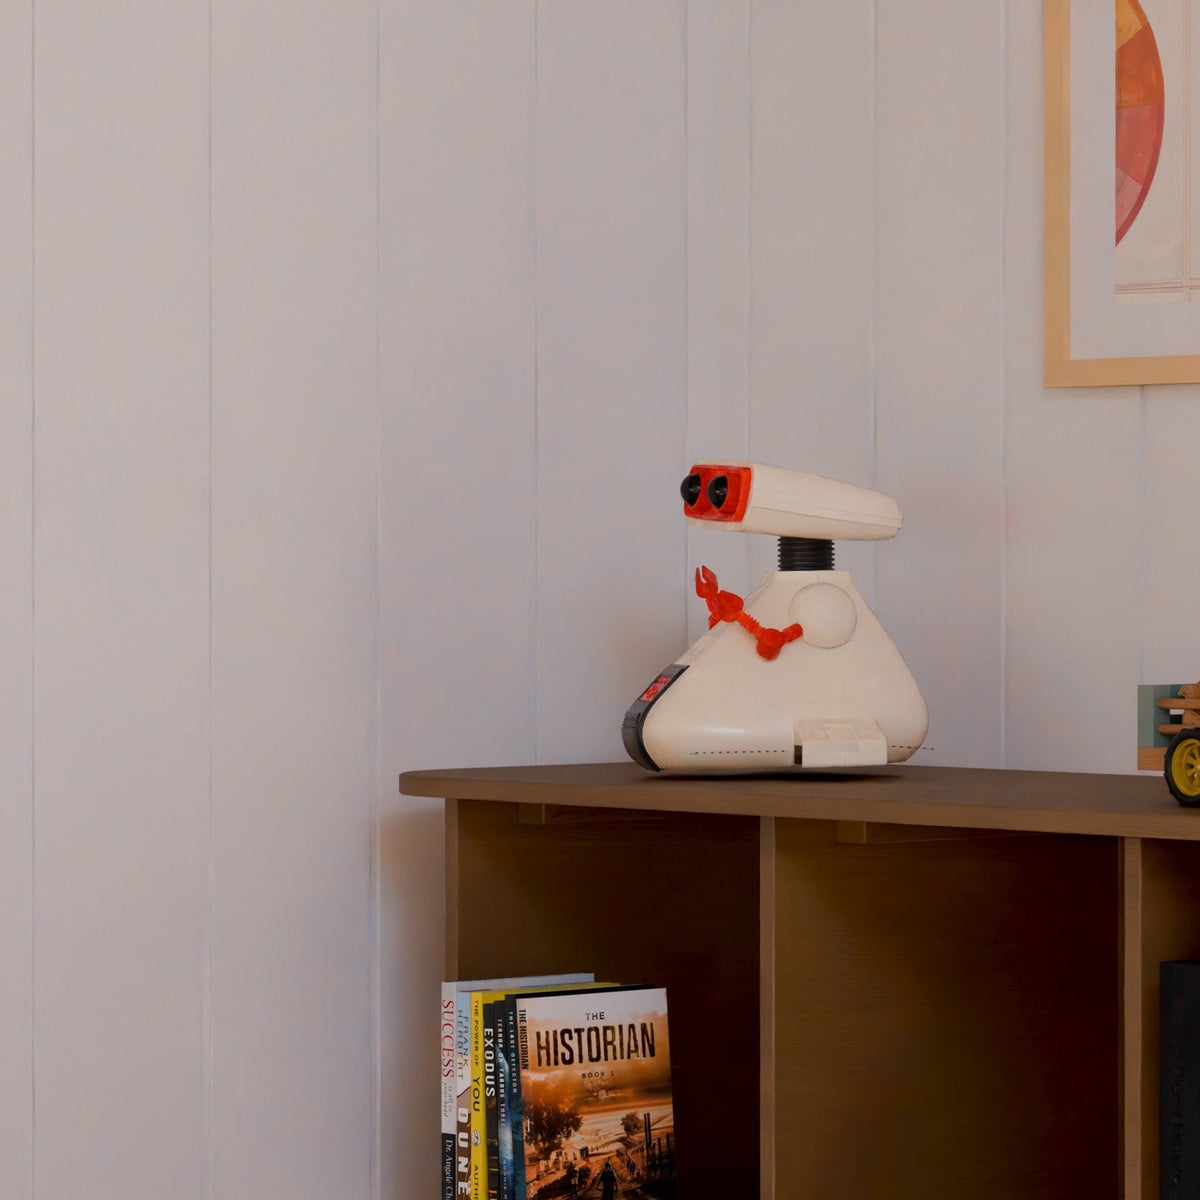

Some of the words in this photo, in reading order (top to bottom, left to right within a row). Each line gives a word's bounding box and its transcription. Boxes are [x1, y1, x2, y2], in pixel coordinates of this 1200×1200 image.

[518, 1009, 527, 1024] THE
[585, 1011, 606, 1021] THE
[442, 1000, 455, 1078] SUCCESS
[519, 1025, 529, 1070] HISTORIAN
[536, 1022, 656, 1067] HISTORIAN
[484, 1028, 495, 1097] EXODUS
[581, 1071, 608, 1080] BOOK
[473, 1076, 481, 1112] YOU
[458, 1108, 470, 1196] DUNE
